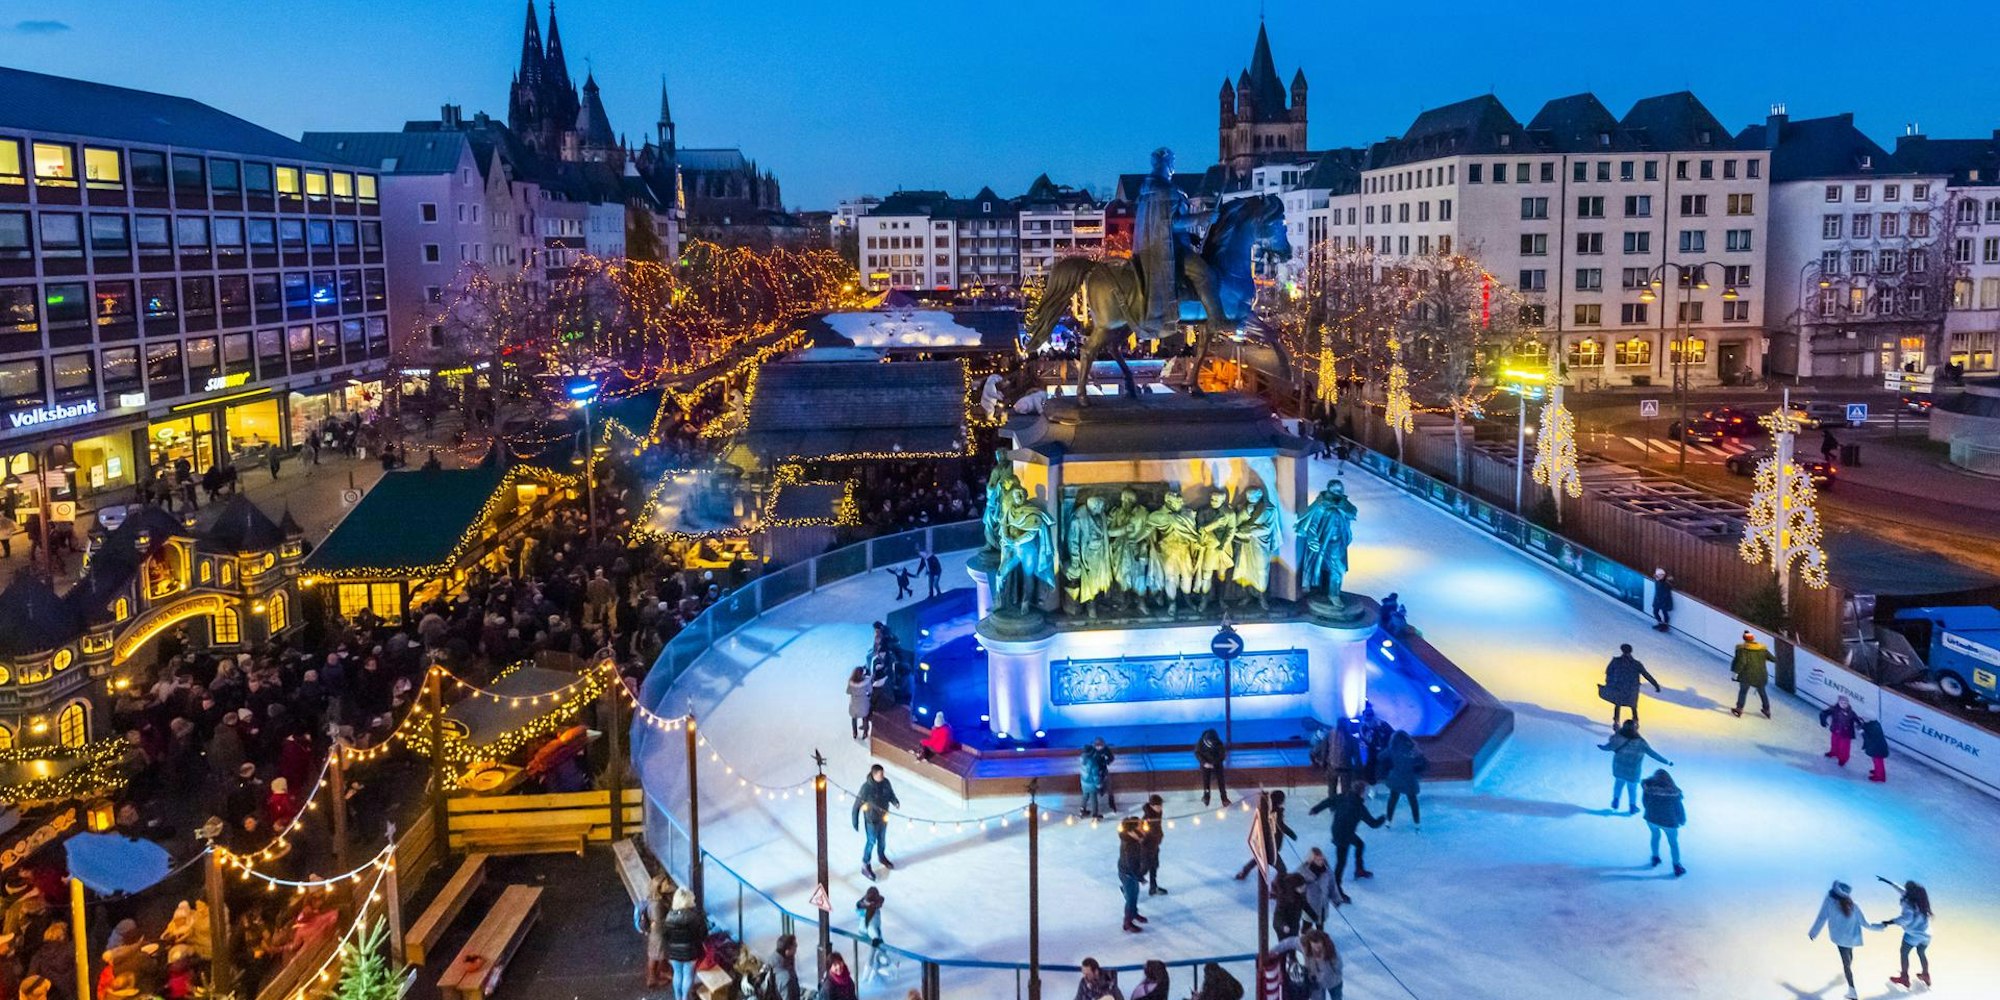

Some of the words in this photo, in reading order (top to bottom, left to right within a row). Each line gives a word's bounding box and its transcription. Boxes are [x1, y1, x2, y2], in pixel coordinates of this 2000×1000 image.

[9, 400, 97, 428] Volksbank
[1824, 677, 1865, 704] LENTPARK
[1921, 724, 1980, 757] LENTPARK
